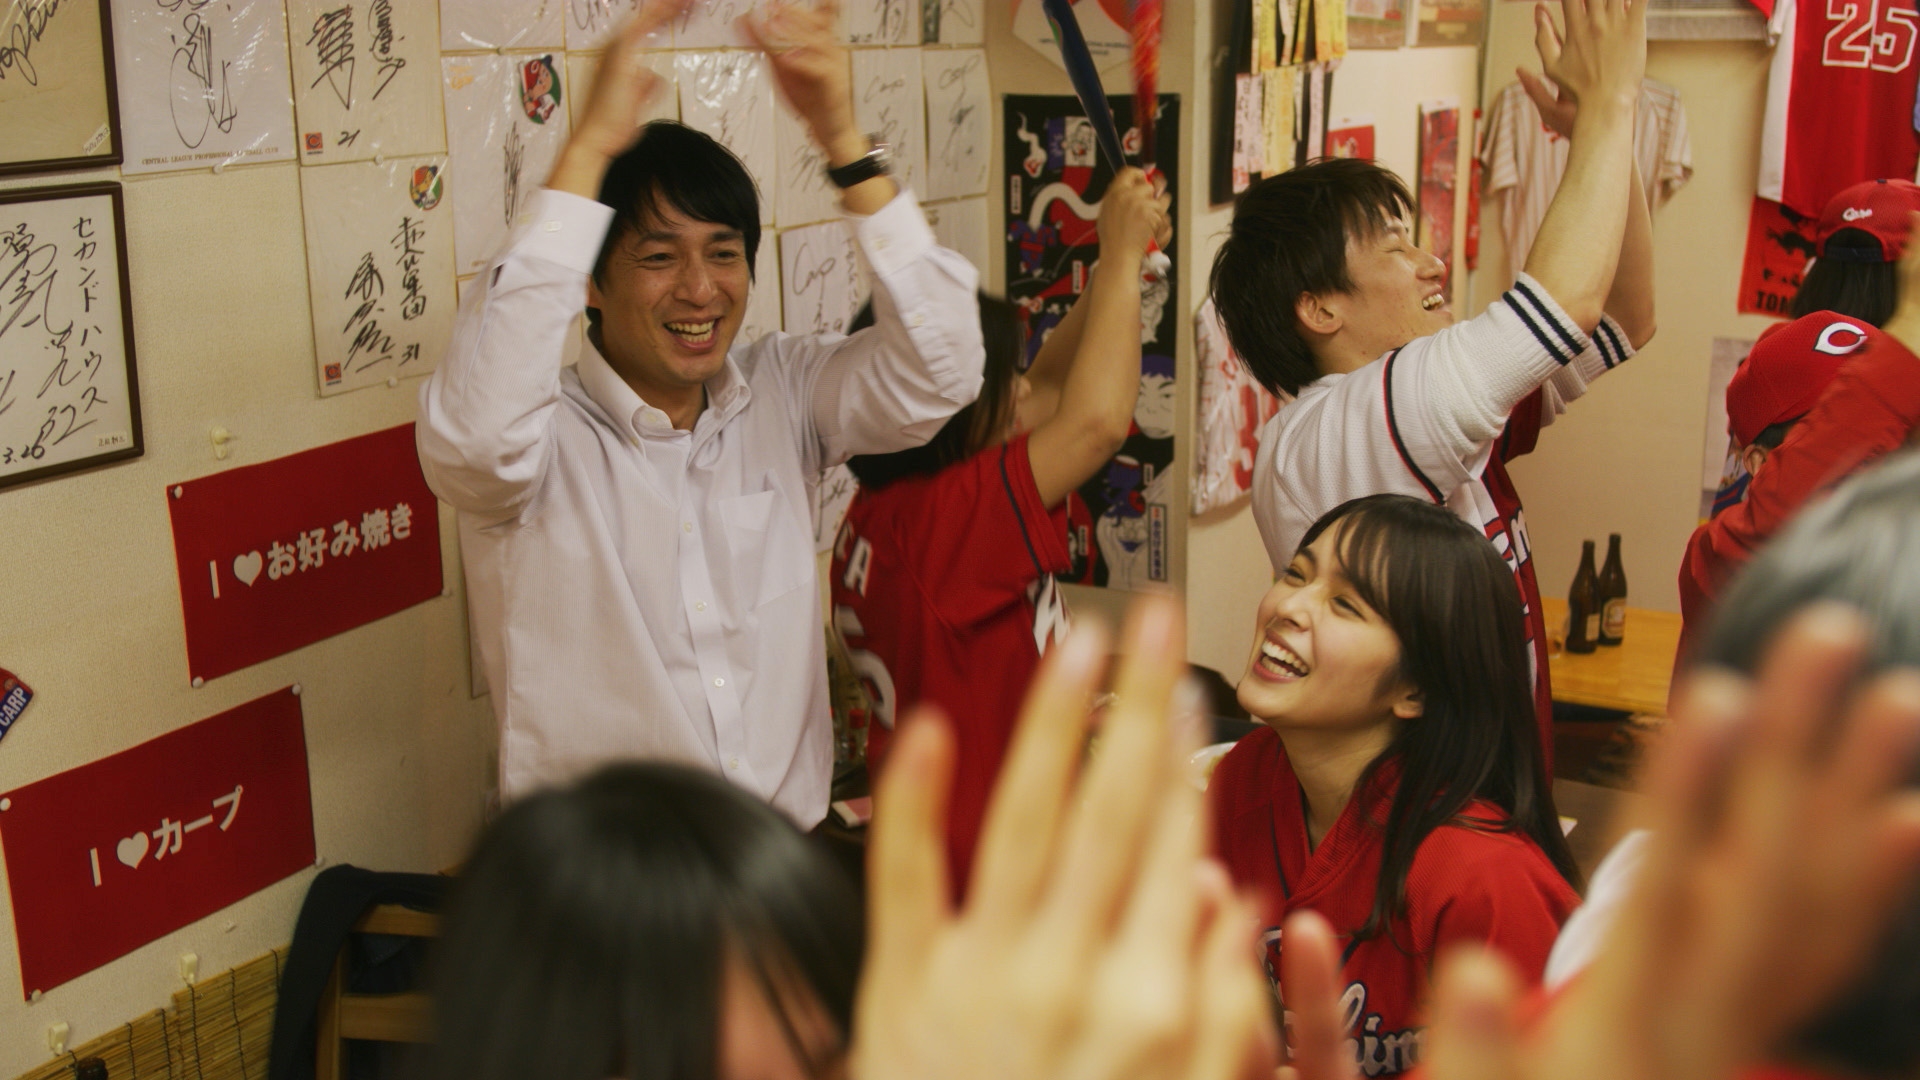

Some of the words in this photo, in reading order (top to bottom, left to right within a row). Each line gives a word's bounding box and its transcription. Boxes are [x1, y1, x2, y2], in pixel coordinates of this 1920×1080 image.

[1822, 0, 1919, 74] 25
[141, 156, 169, 166] CENTRAL
[170, 153, 193, 163] LEAGUE
[194, 150, 233, 162] PROFESSIONAL
[73, 217, 108, 413] セカンドハウス
[266, 502, 413, 581] お好み焼き
[0, 687, 28, 727] CARP
[152, 784, 244, 862] カープ
